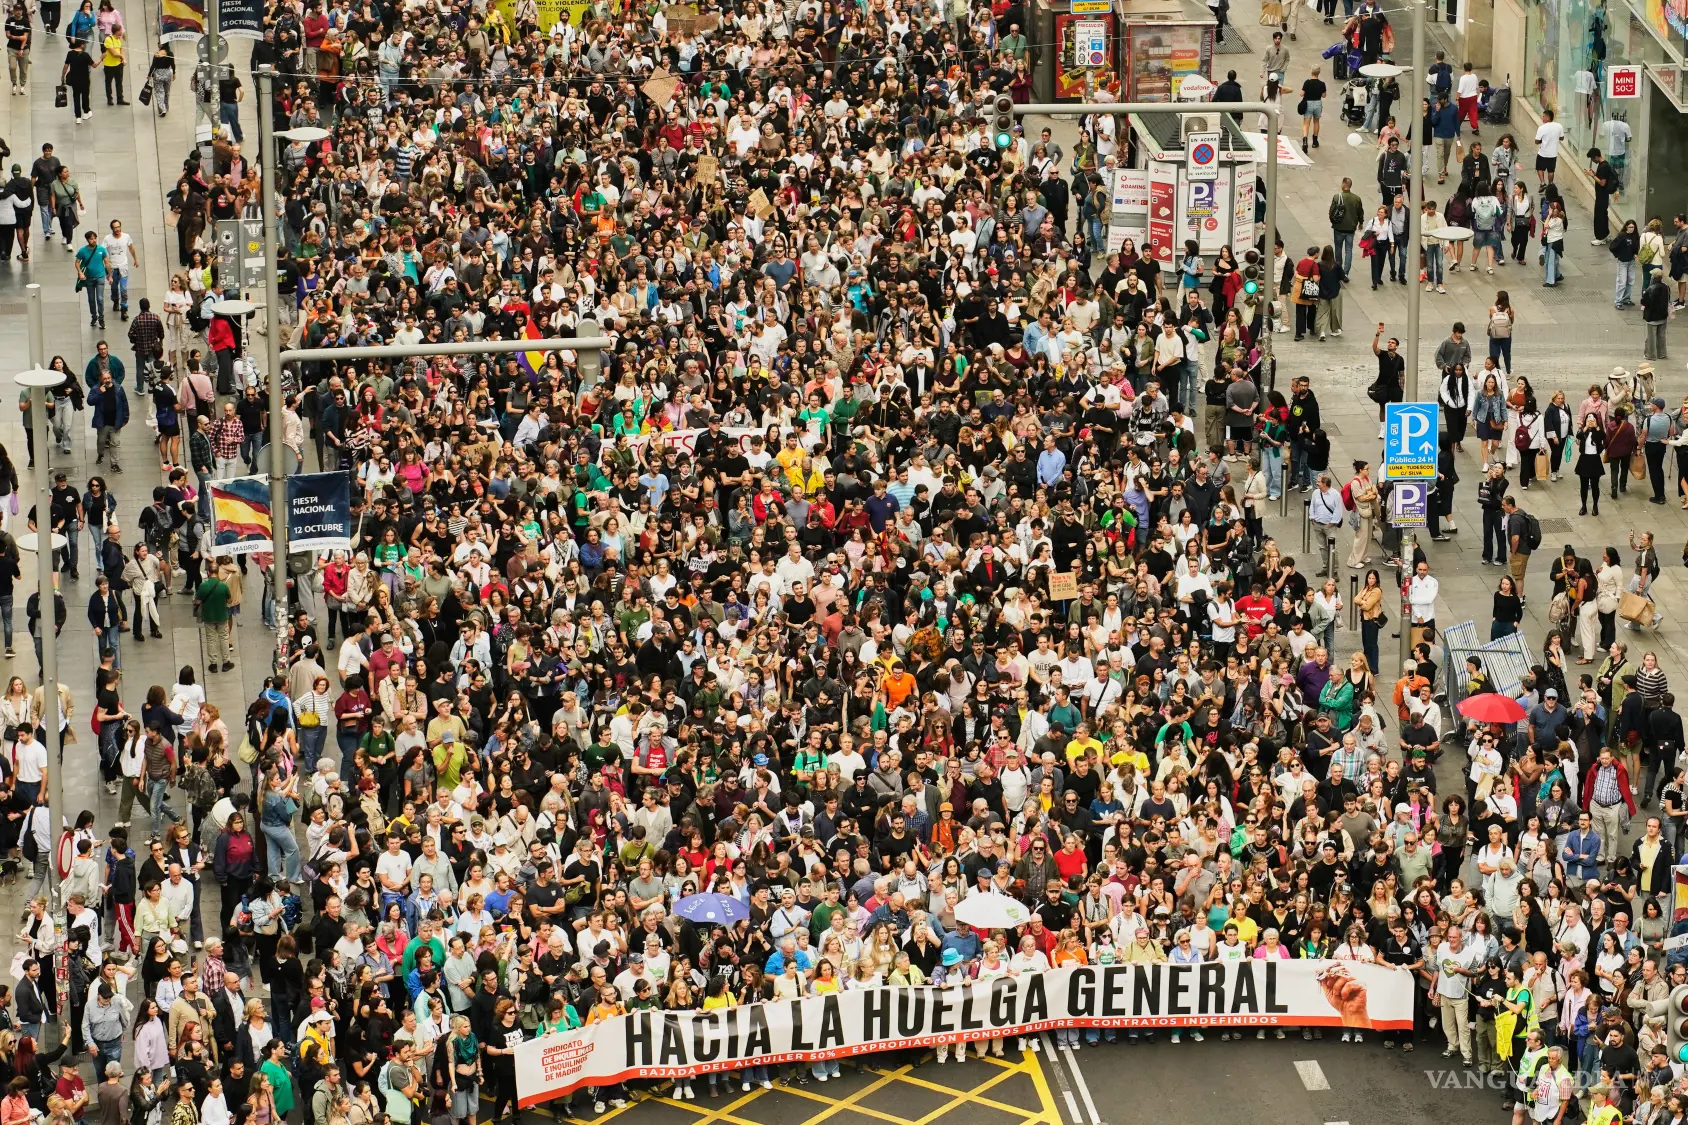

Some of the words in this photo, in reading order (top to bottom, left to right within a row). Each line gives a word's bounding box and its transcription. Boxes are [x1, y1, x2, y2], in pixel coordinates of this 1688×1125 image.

[229, 19, 259, 28] OCTUBRE
[1615, 76, 1634, 84] MINI
[1188, 182, 1210, 208] P
[1395, 412, 1430, 456] P
[292, 496, 319, 506] FIESTA
[1395, 484, 1421, 515] P
[293, 504, 336, 515] NACIONAL
[293, 526, 303, 535] 12
[304, 523, 344, 533] OCTUBRE
[232, 543, 259, 553] MADRID
[720, 899, 734, 917] 7291
[625, 1004, 772, 1067] HACIA
[791, 994, 845, 1051] LA
[863, 973, 1048, 1042] HUELGA
[1067, 961, 1288, 1017] GENERAL
[543, 1039, 583, 1056] SINDICATO
[553, 1044, 593, 1062] INQUILINAS
[639, 1066, 697, 1077] BAJADA
[701, 1062, 728, 1072] DEL
[734, 1053, 804, 1067] ALQUILER
[809, 1050, 836, 1060] 50%
[852, 1033, 957, 1054] EXPROPIACIÓN
[963, 1027, 1019, 1041] FONDOS
[1025, 1019, 1074, 1032] BUITRE
[1091, 1017, 1177, 1027] CONTRATOS
[1183, 1016, 1278, 1025] INDEFINIDOS
[544, 1066, 549, 1074] E
[549, 1055, 588, 1073] INQUILINOS
[545, 1073, 555, 1081] DE
[555, 1064, 583, 1079] MADRID
